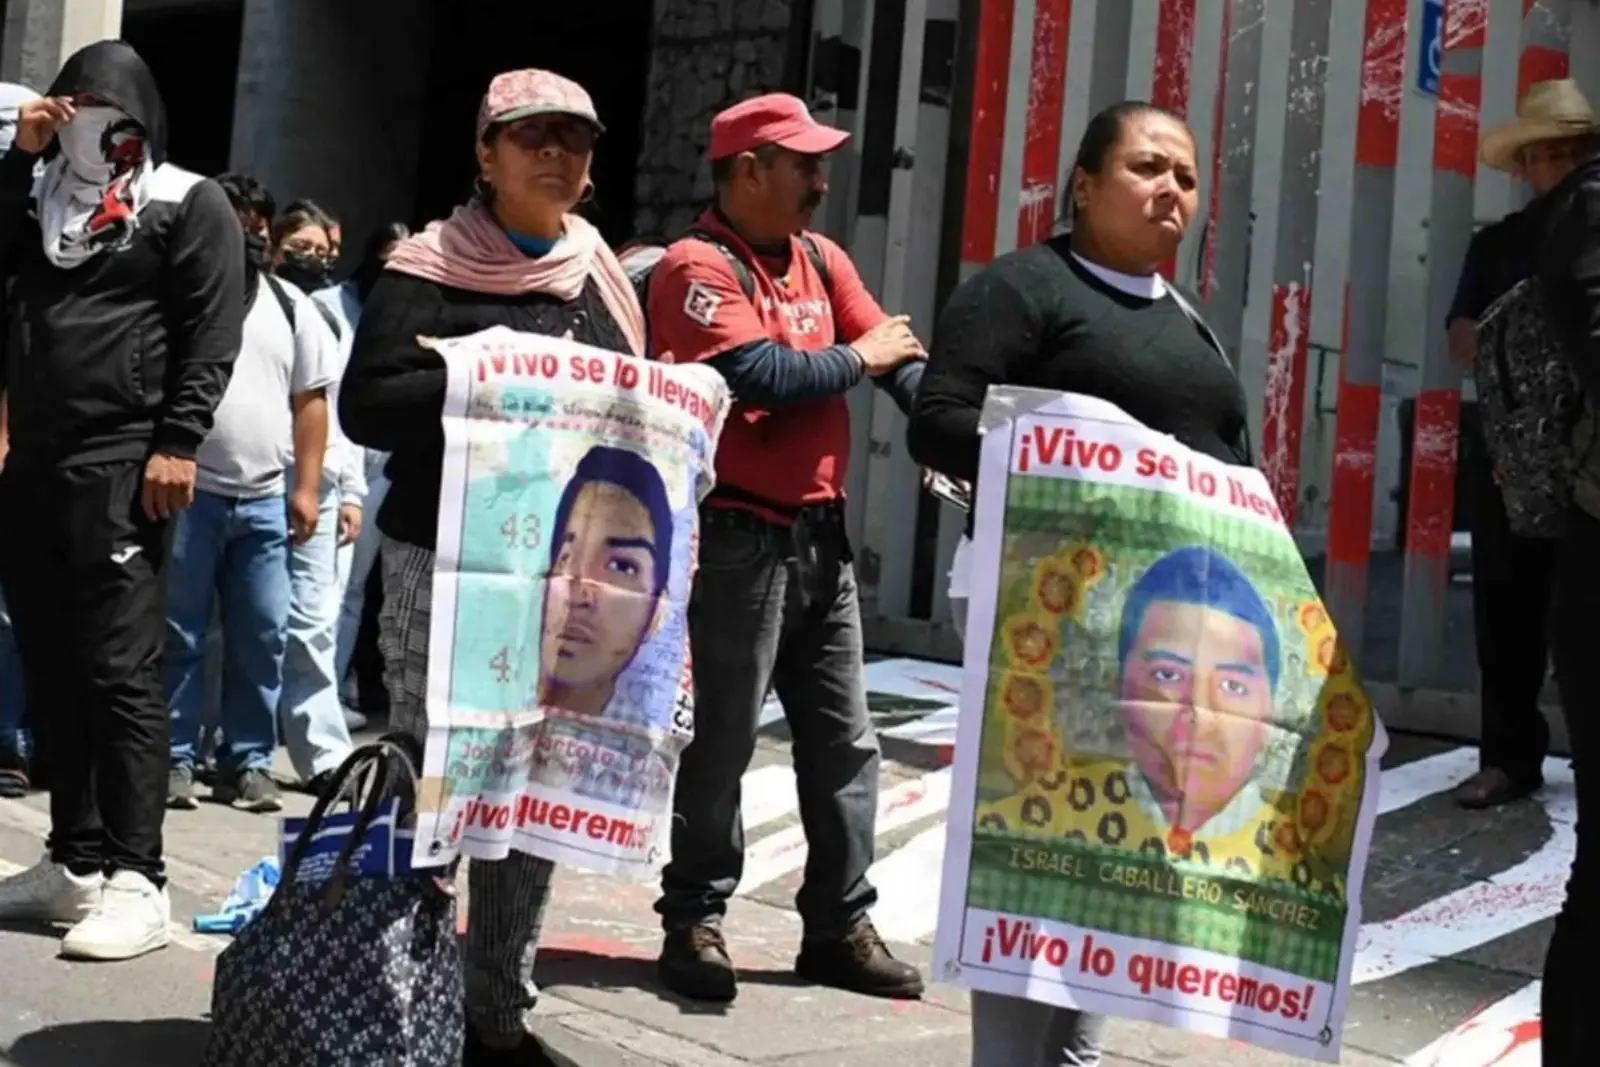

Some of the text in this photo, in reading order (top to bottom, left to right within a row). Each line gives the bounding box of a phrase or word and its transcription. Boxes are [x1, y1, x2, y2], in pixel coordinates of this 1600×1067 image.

[570, 355, 605, 383] se
[613, 356, 639, 390] lo
[1017, 424, 1122, 473] ¡Vivo
[1136, 447, 1179, 481] se
[1186, 460, 1216, 497] lo
[500, 513, 542, 550] 43
[1008, 846, 1086, 878] ISRAEL
[1100, 862, 1222, 905] CABALLERO
[981, 917, 1315, 1022] ¡Vivo lo queremos!
